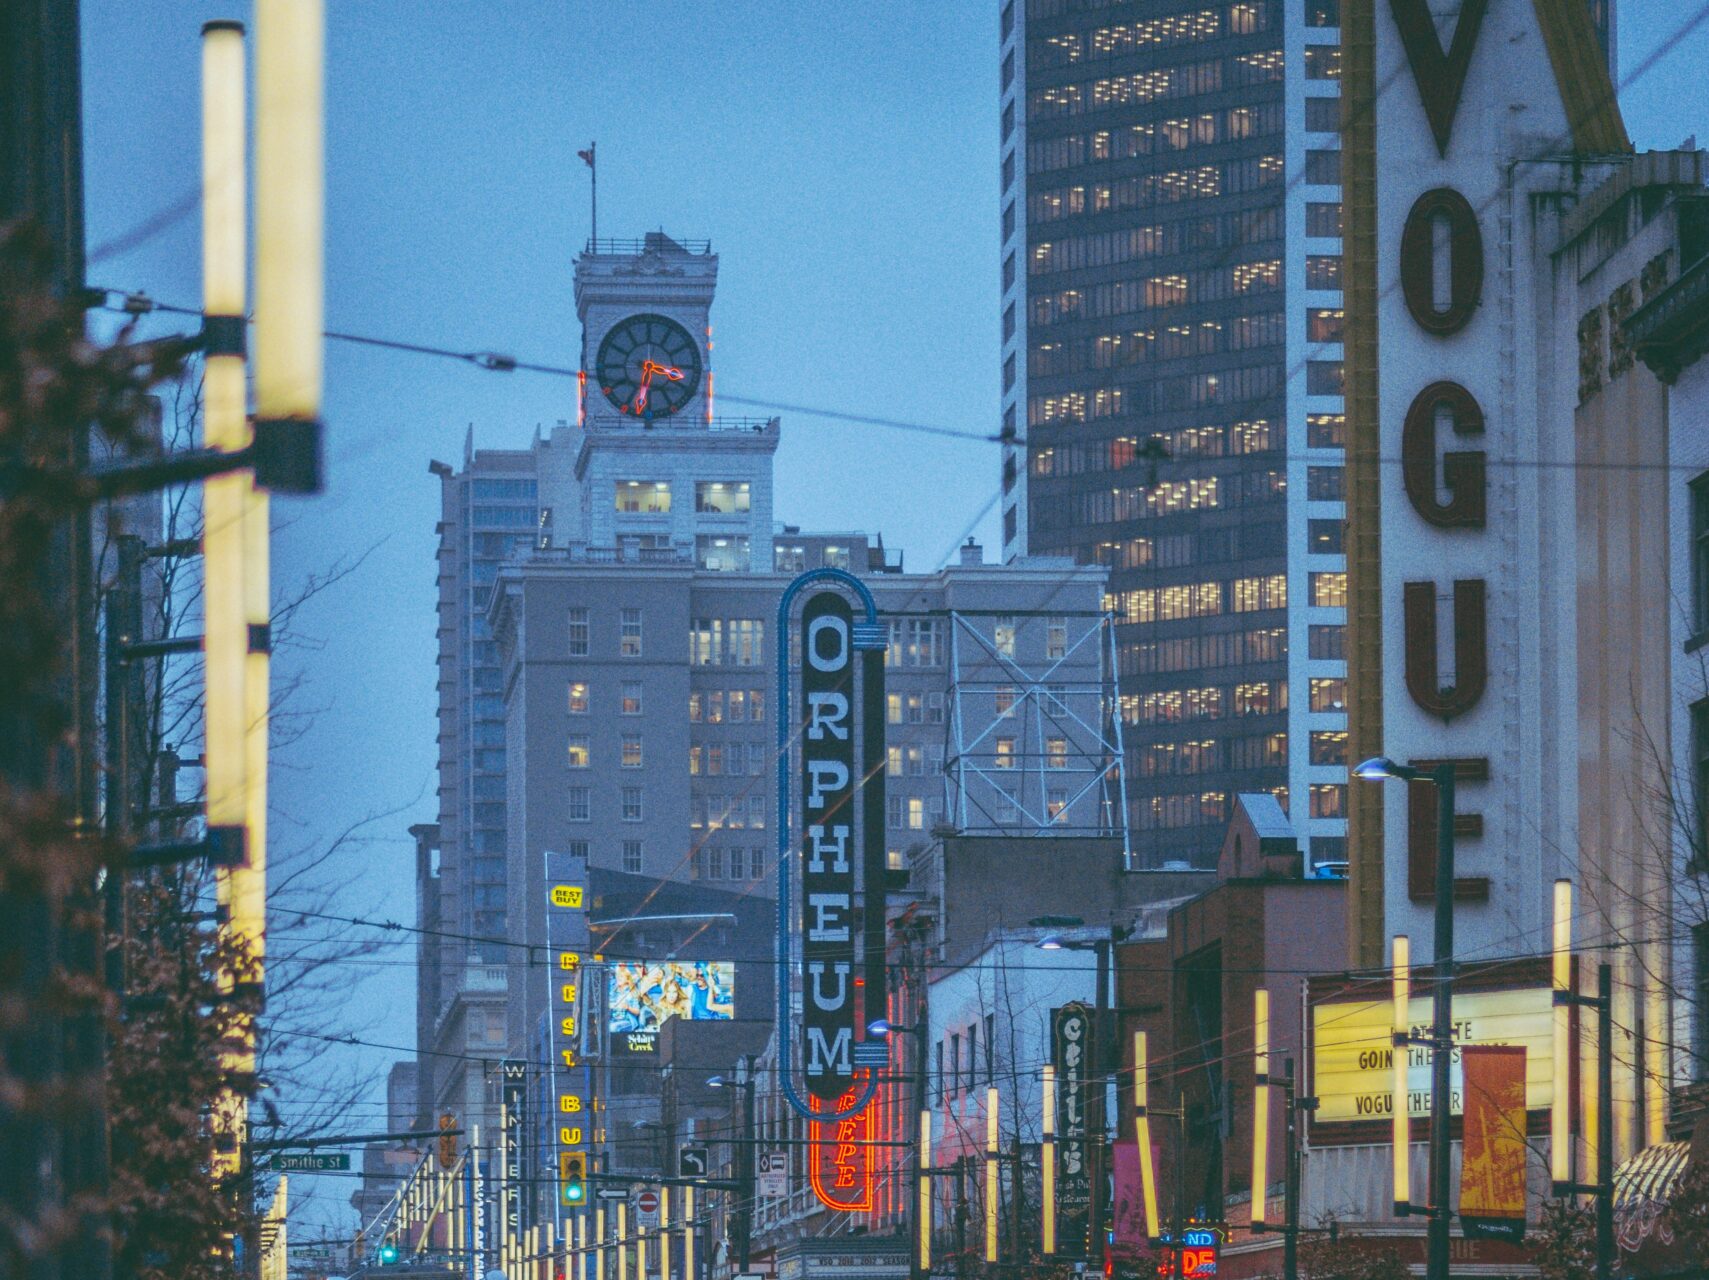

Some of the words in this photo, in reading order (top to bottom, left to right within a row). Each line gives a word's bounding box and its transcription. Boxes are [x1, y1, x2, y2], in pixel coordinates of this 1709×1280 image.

[1388, 0, 1489, 902] VOGUE
[807, 615, 852, 1076] ORPHEUM
[555, 889, 582, 898] BEST
[556, 896, 578, 904] BUY
[1358, 1050, 1393, 1070] GOIN
[1355, 1095, 1393, 1115] VOGU
[560, 1095, 582, 1145] BU
[280, 1155, 324, 1169] Smithe
[329, 1156, 341, 1169] St
